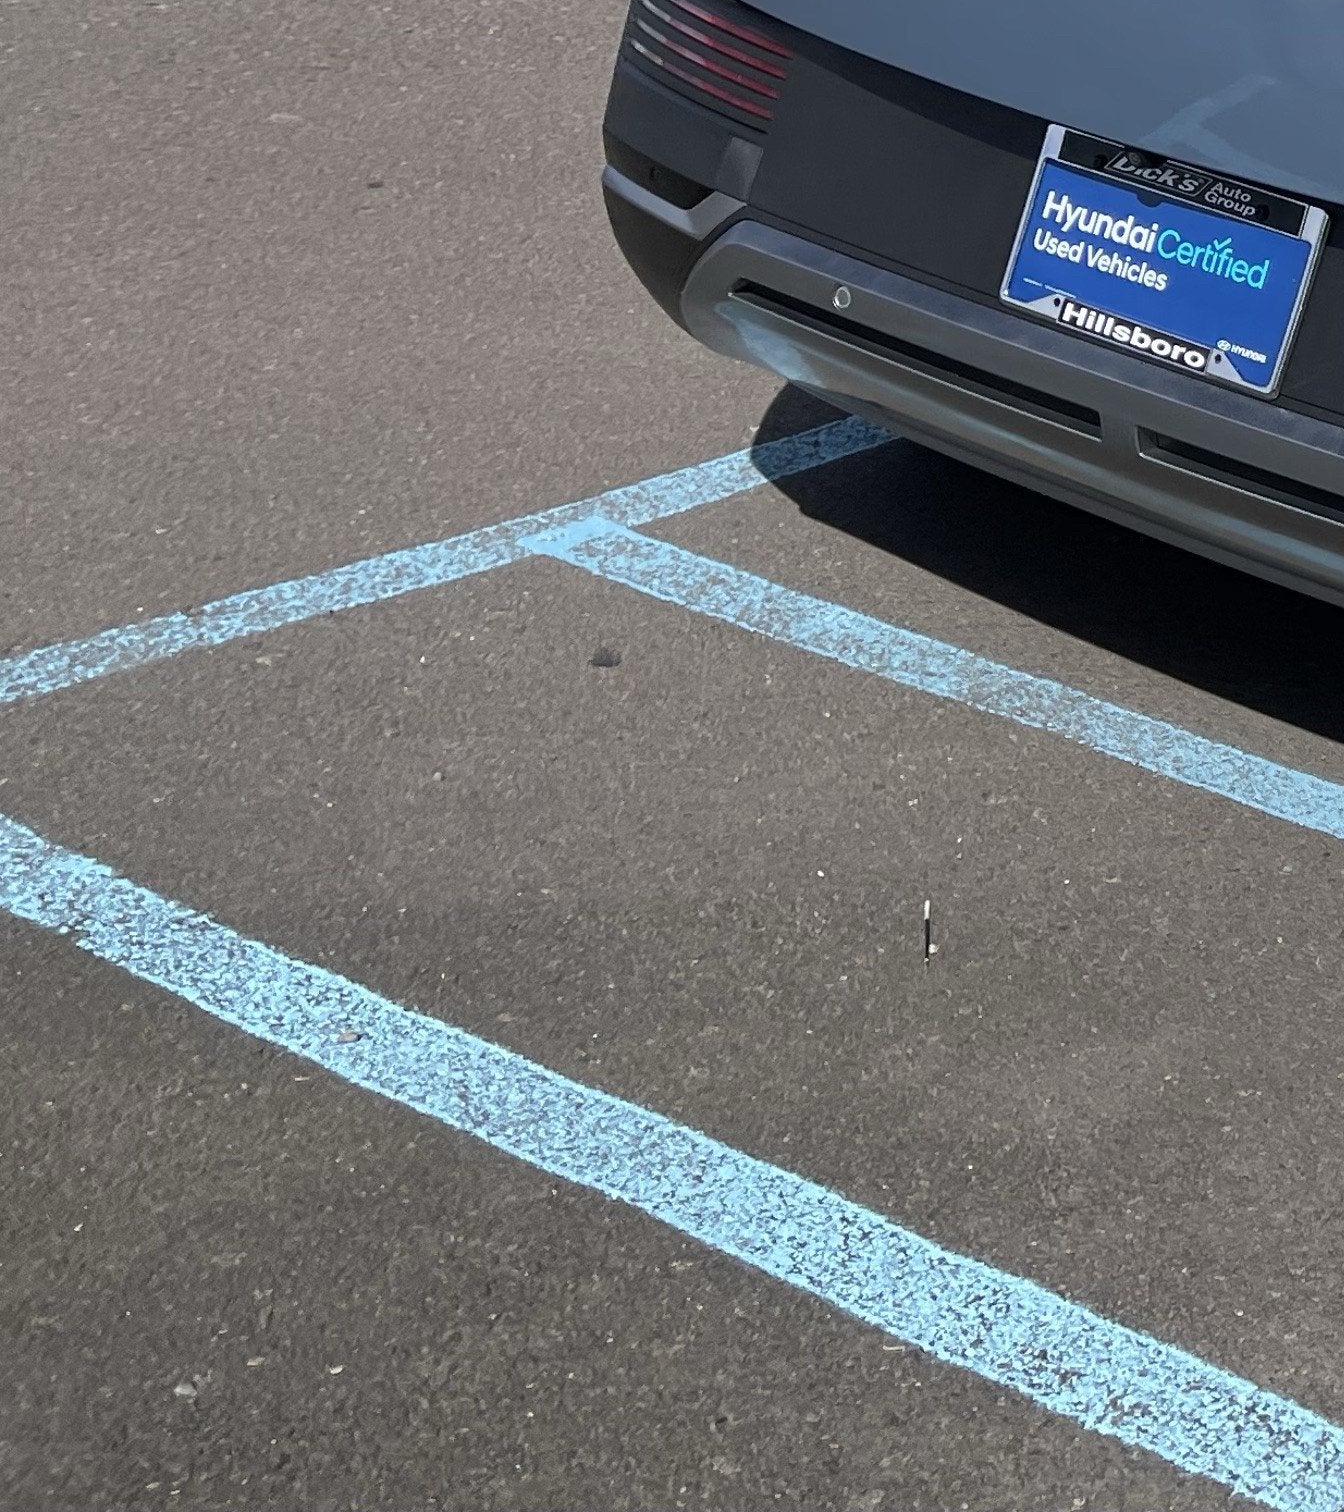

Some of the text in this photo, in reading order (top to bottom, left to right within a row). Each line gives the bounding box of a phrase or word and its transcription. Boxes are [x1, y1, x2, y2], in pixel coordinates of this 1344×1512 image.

[1204, 191, 1256, 217] Group
[1211, 182, 1252, 202] Auto
[1034, 229, 1169, 291] Used Vehicles
[1042, 190, 1270, 289] Hyundai Certified
[1062, 302, 1205, 369] Hillsboro
[1230, 344, 1267, 364] HYUNDAI
